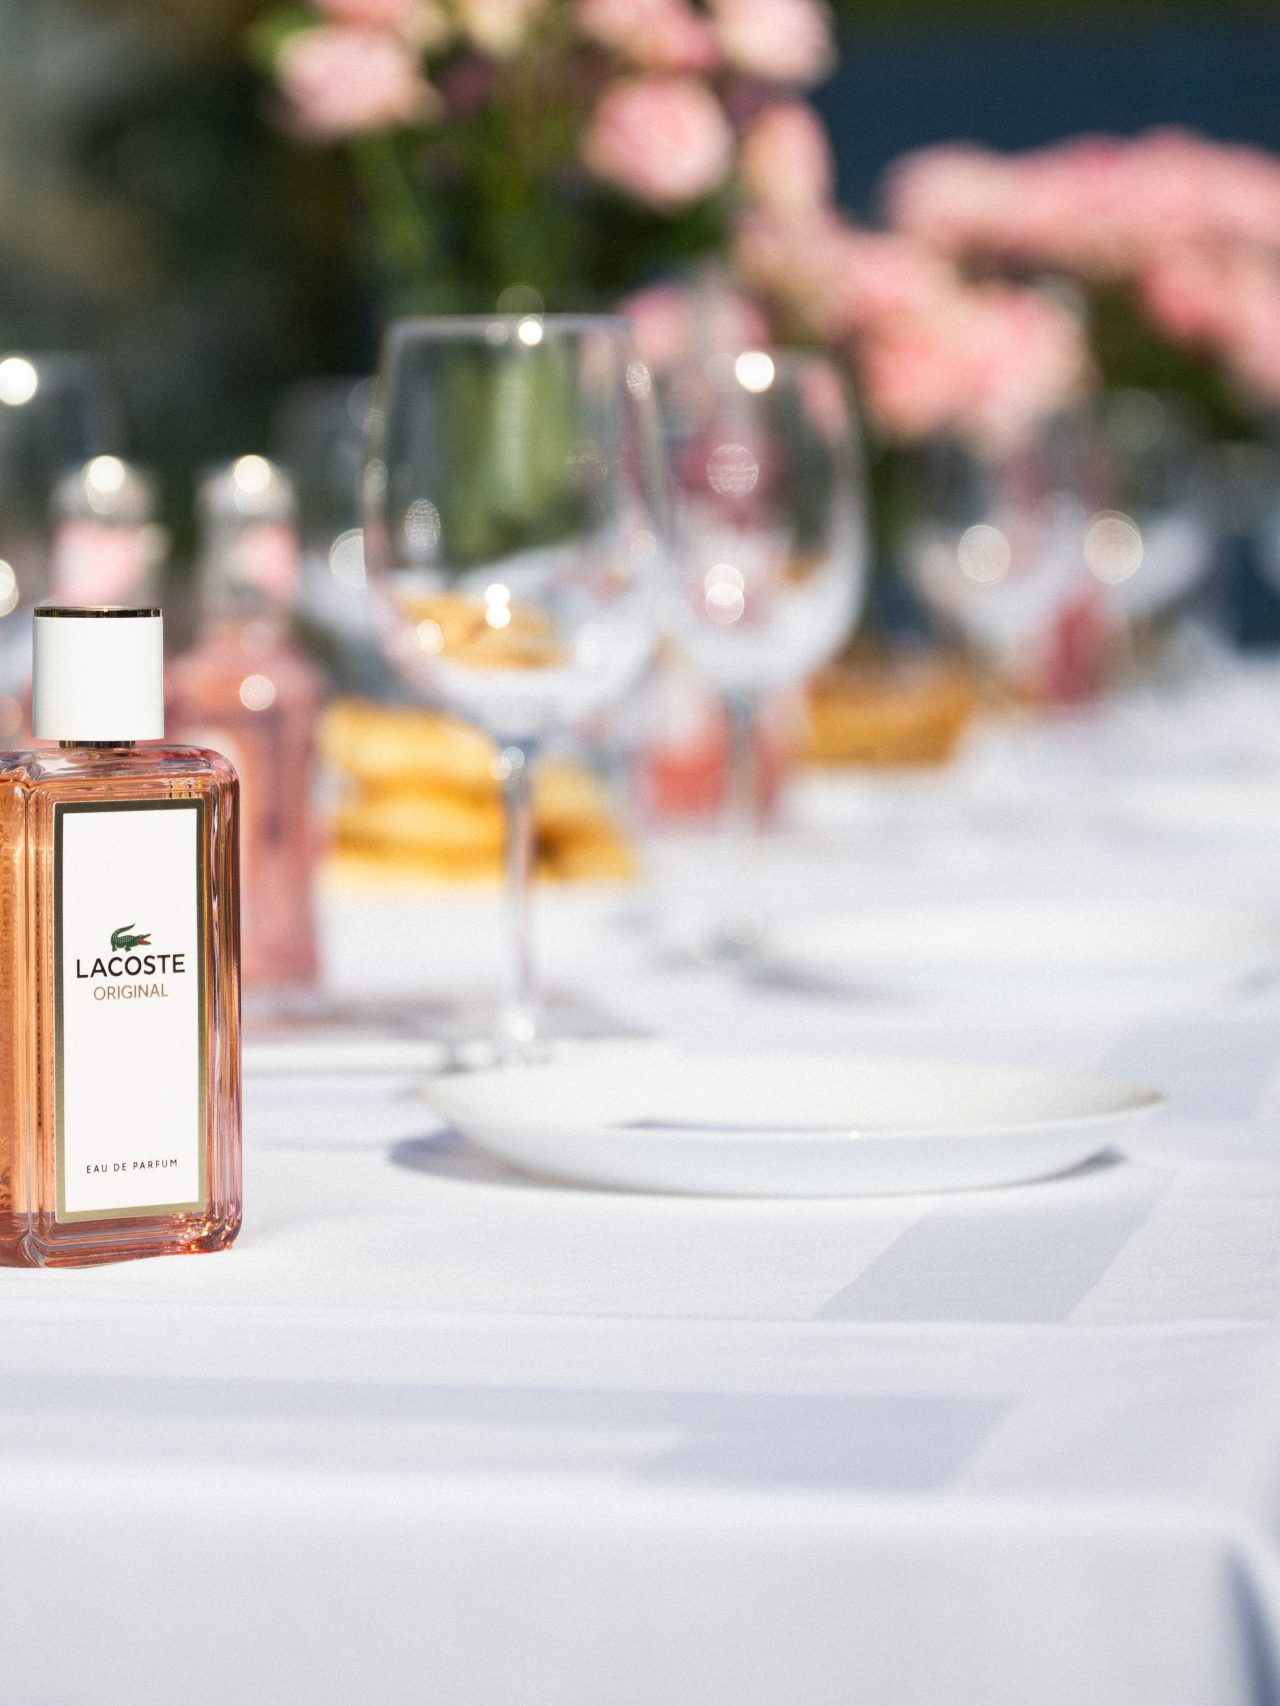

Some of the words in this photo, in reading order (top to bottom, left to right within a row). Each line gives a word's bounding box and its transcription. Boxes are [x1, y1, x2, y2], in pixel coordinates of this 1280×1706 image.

[76, 953, 186, 979] LACOSTE
[93, 983, 169, 1001] ORIGINAL
[86, 1164, 108, 1174] EAU
[113, 1162, 127, 1172] DE
[132, 1159, 178, 1171] PARFUM
